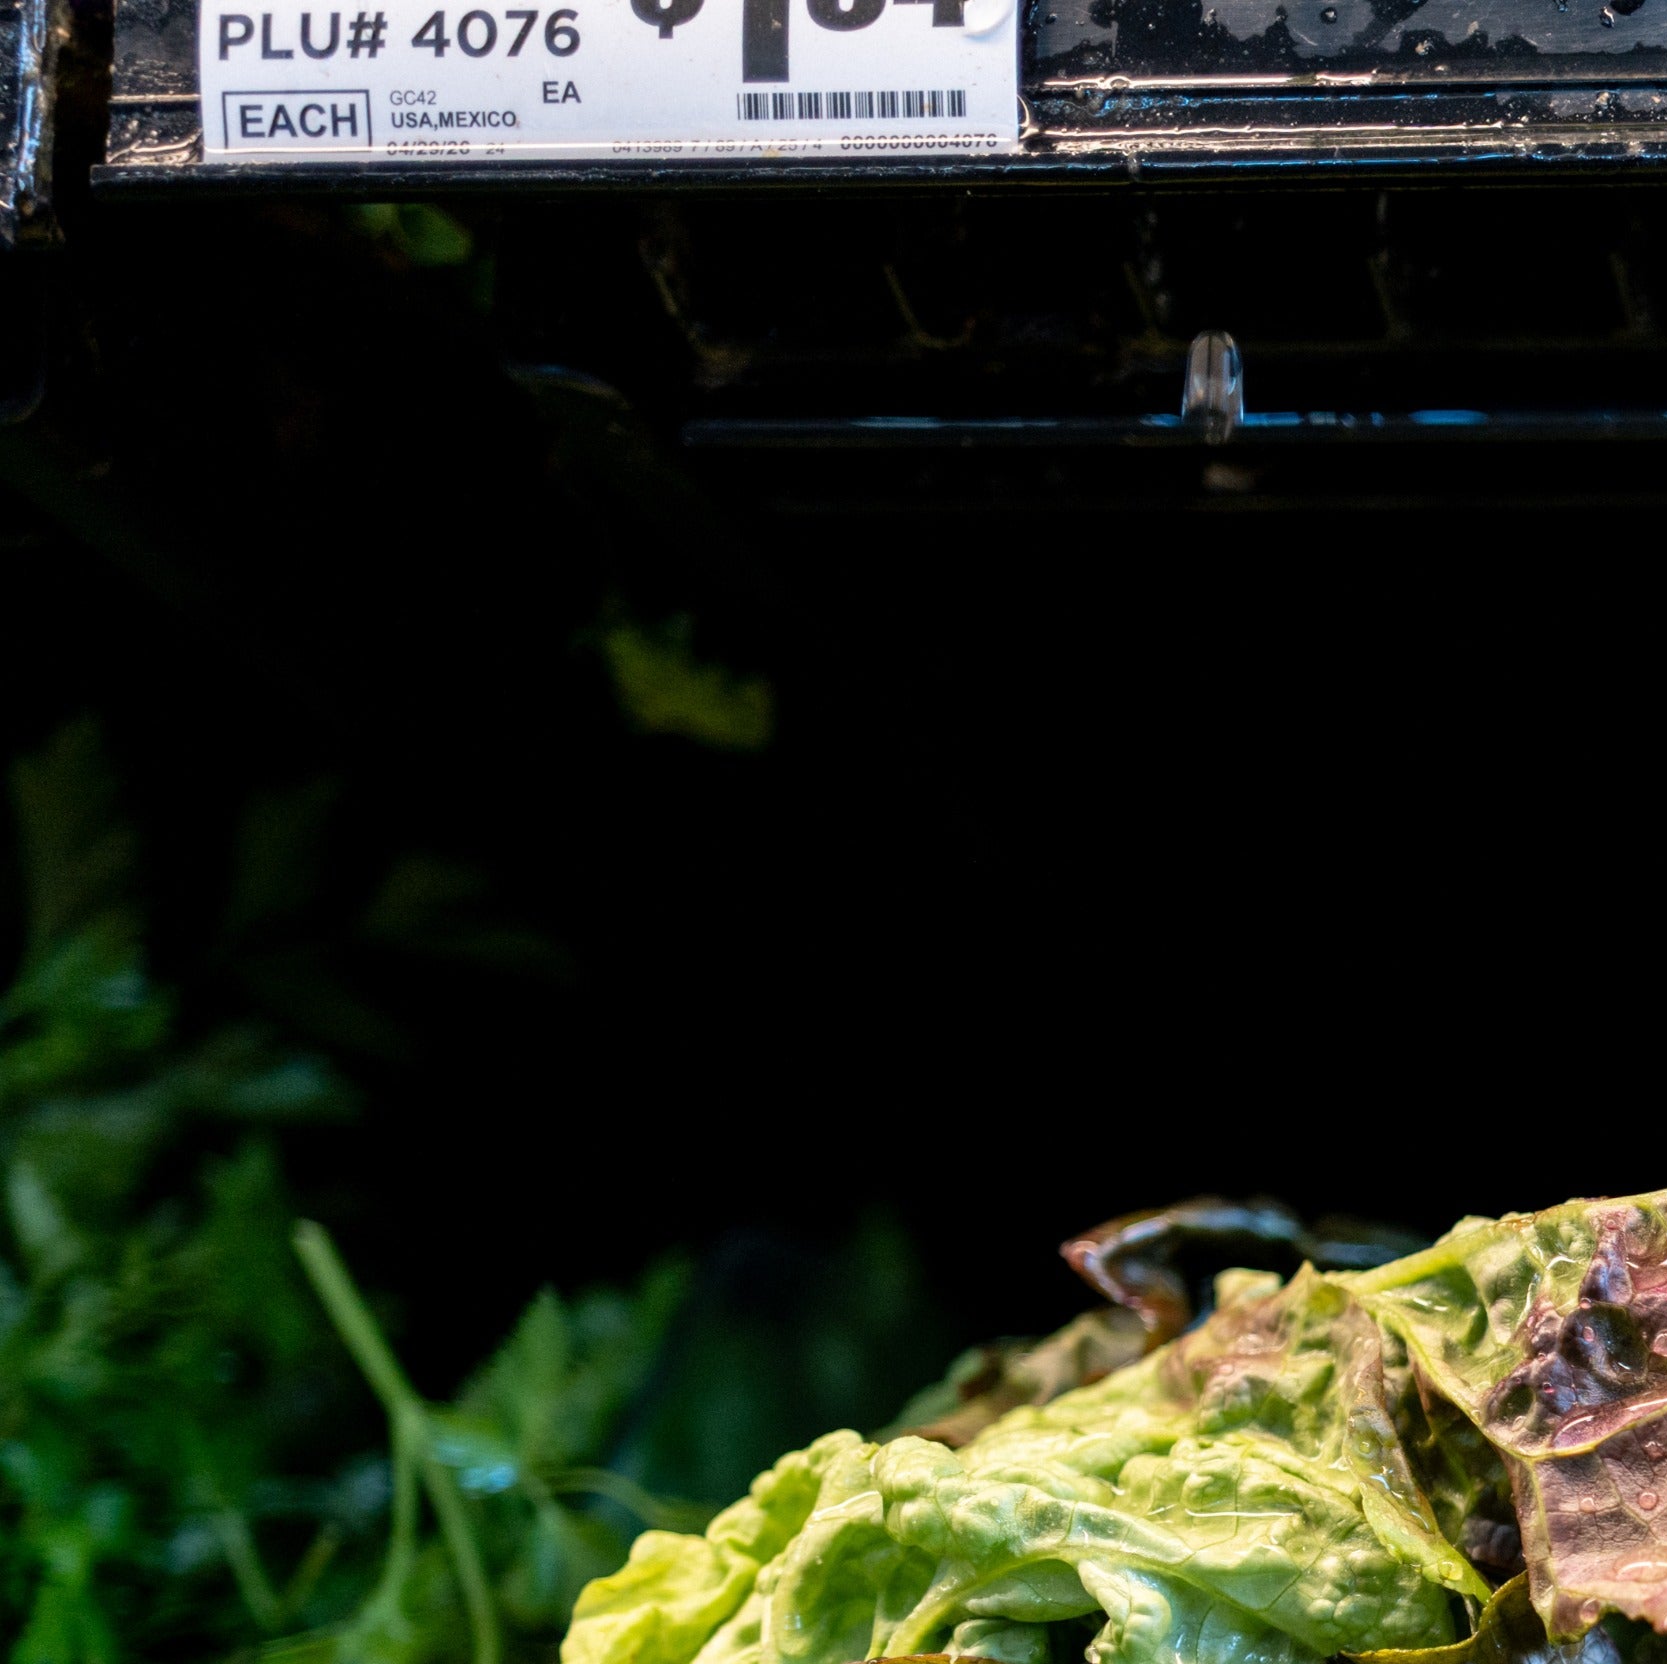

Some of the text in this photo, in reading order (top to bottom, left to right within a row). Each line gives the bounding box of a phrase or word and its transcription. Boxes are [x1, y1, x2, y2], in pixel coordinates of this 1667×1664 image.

[218, 10, 388, 61] PLU#
[411, 8, 582, 59] 4076
[389, 90, 437, 106] GC42
[542, 80, 582, 104] EA
[238, 103, 359, 139] EACH
[391, 110, 517, 131] USA,MEXICO
